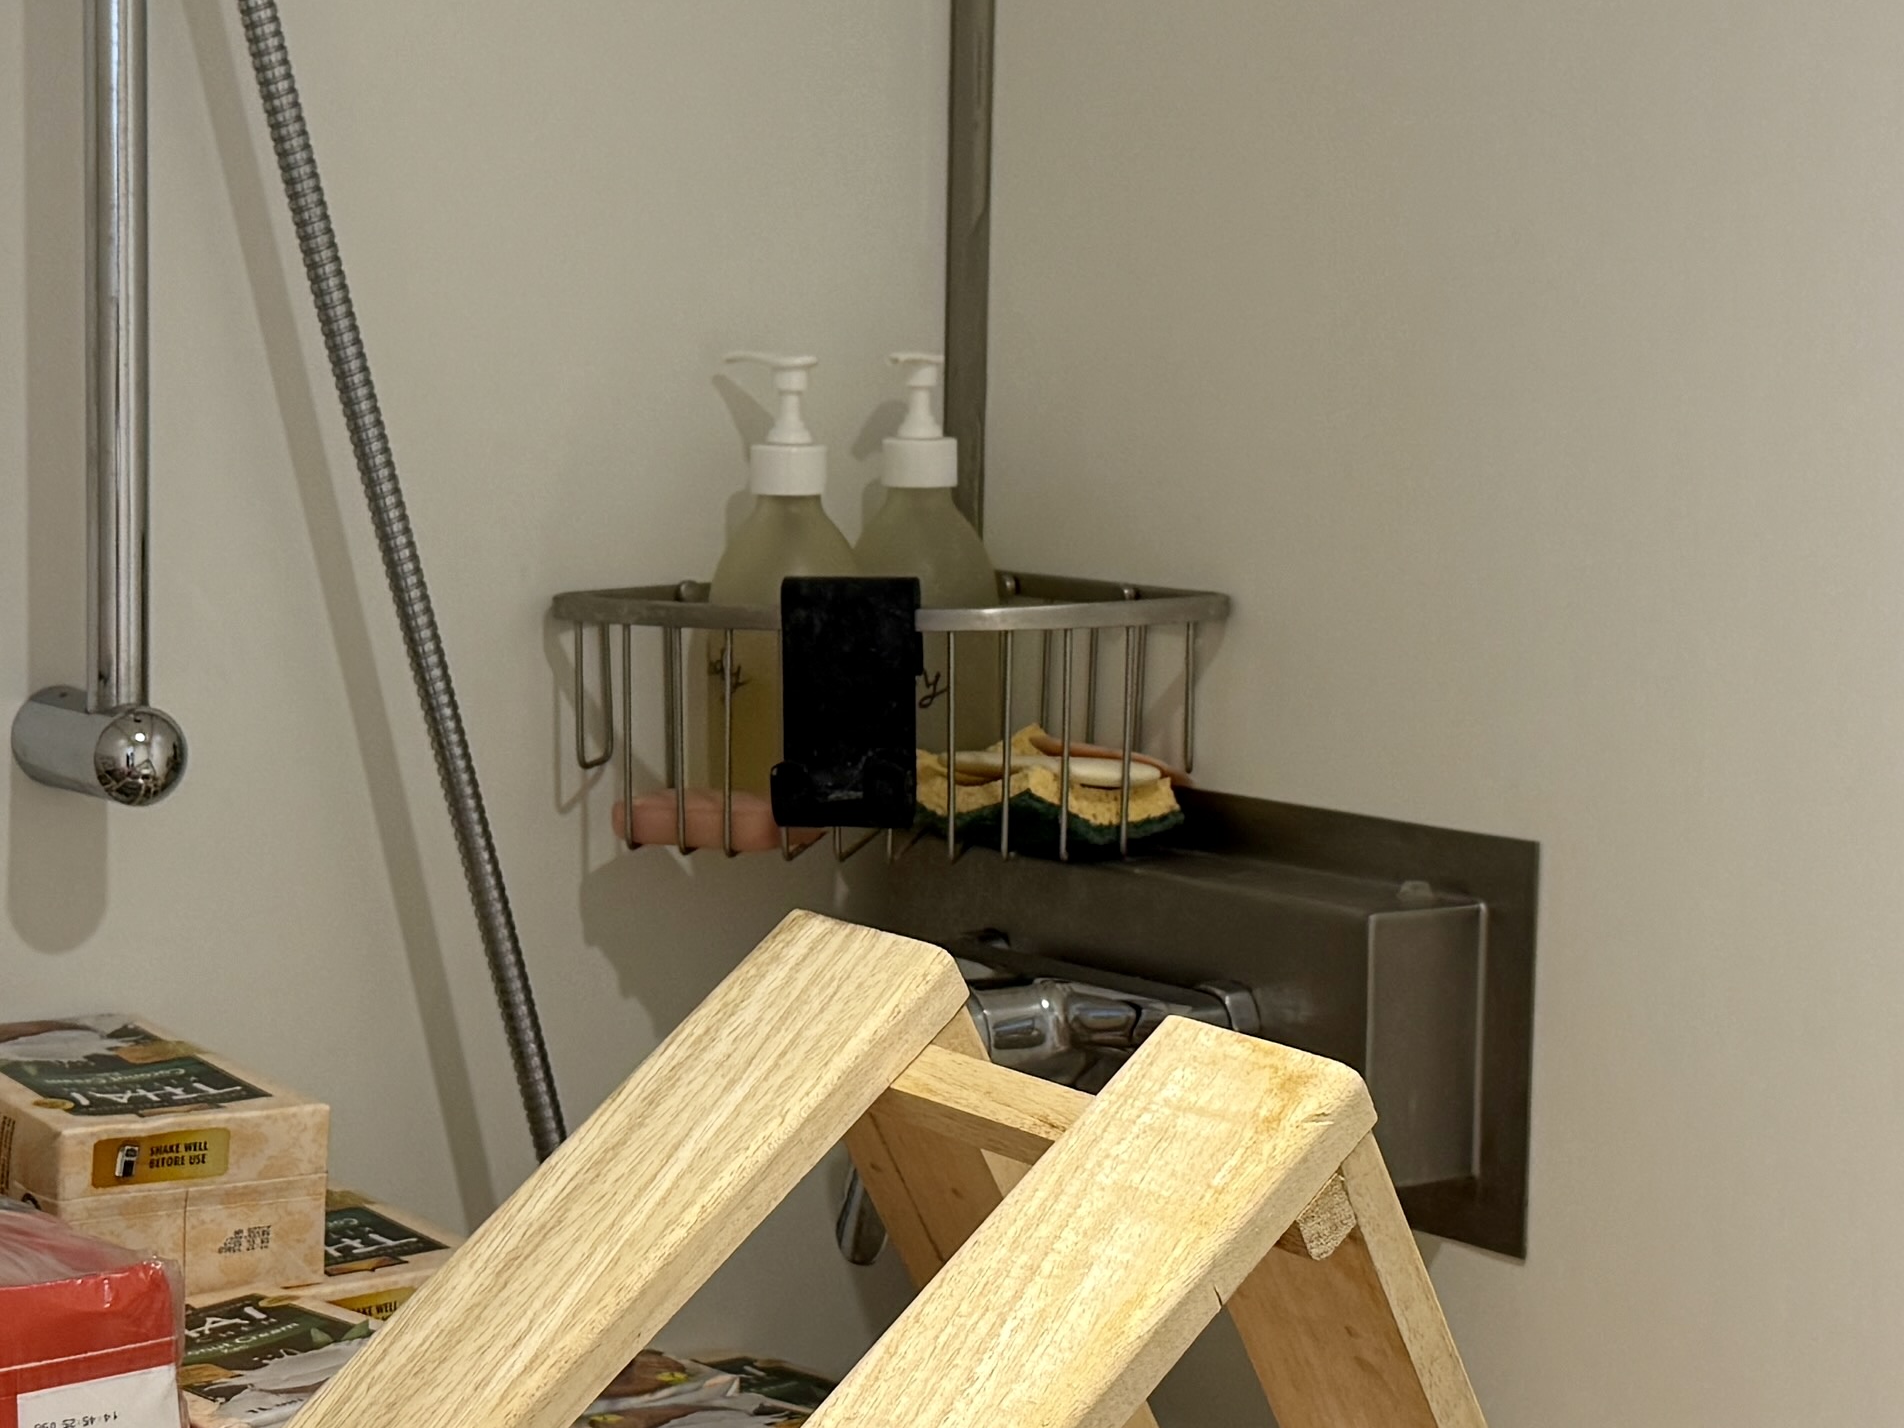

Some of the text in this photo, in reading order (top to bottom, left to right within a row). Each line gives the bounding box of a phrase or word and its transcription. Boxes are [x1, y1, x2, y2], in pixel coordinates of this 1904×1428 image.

[150, 1141, 208, 1156] SHAKE WELL
[149, 1154, 206, 1168] BEFORE USE
